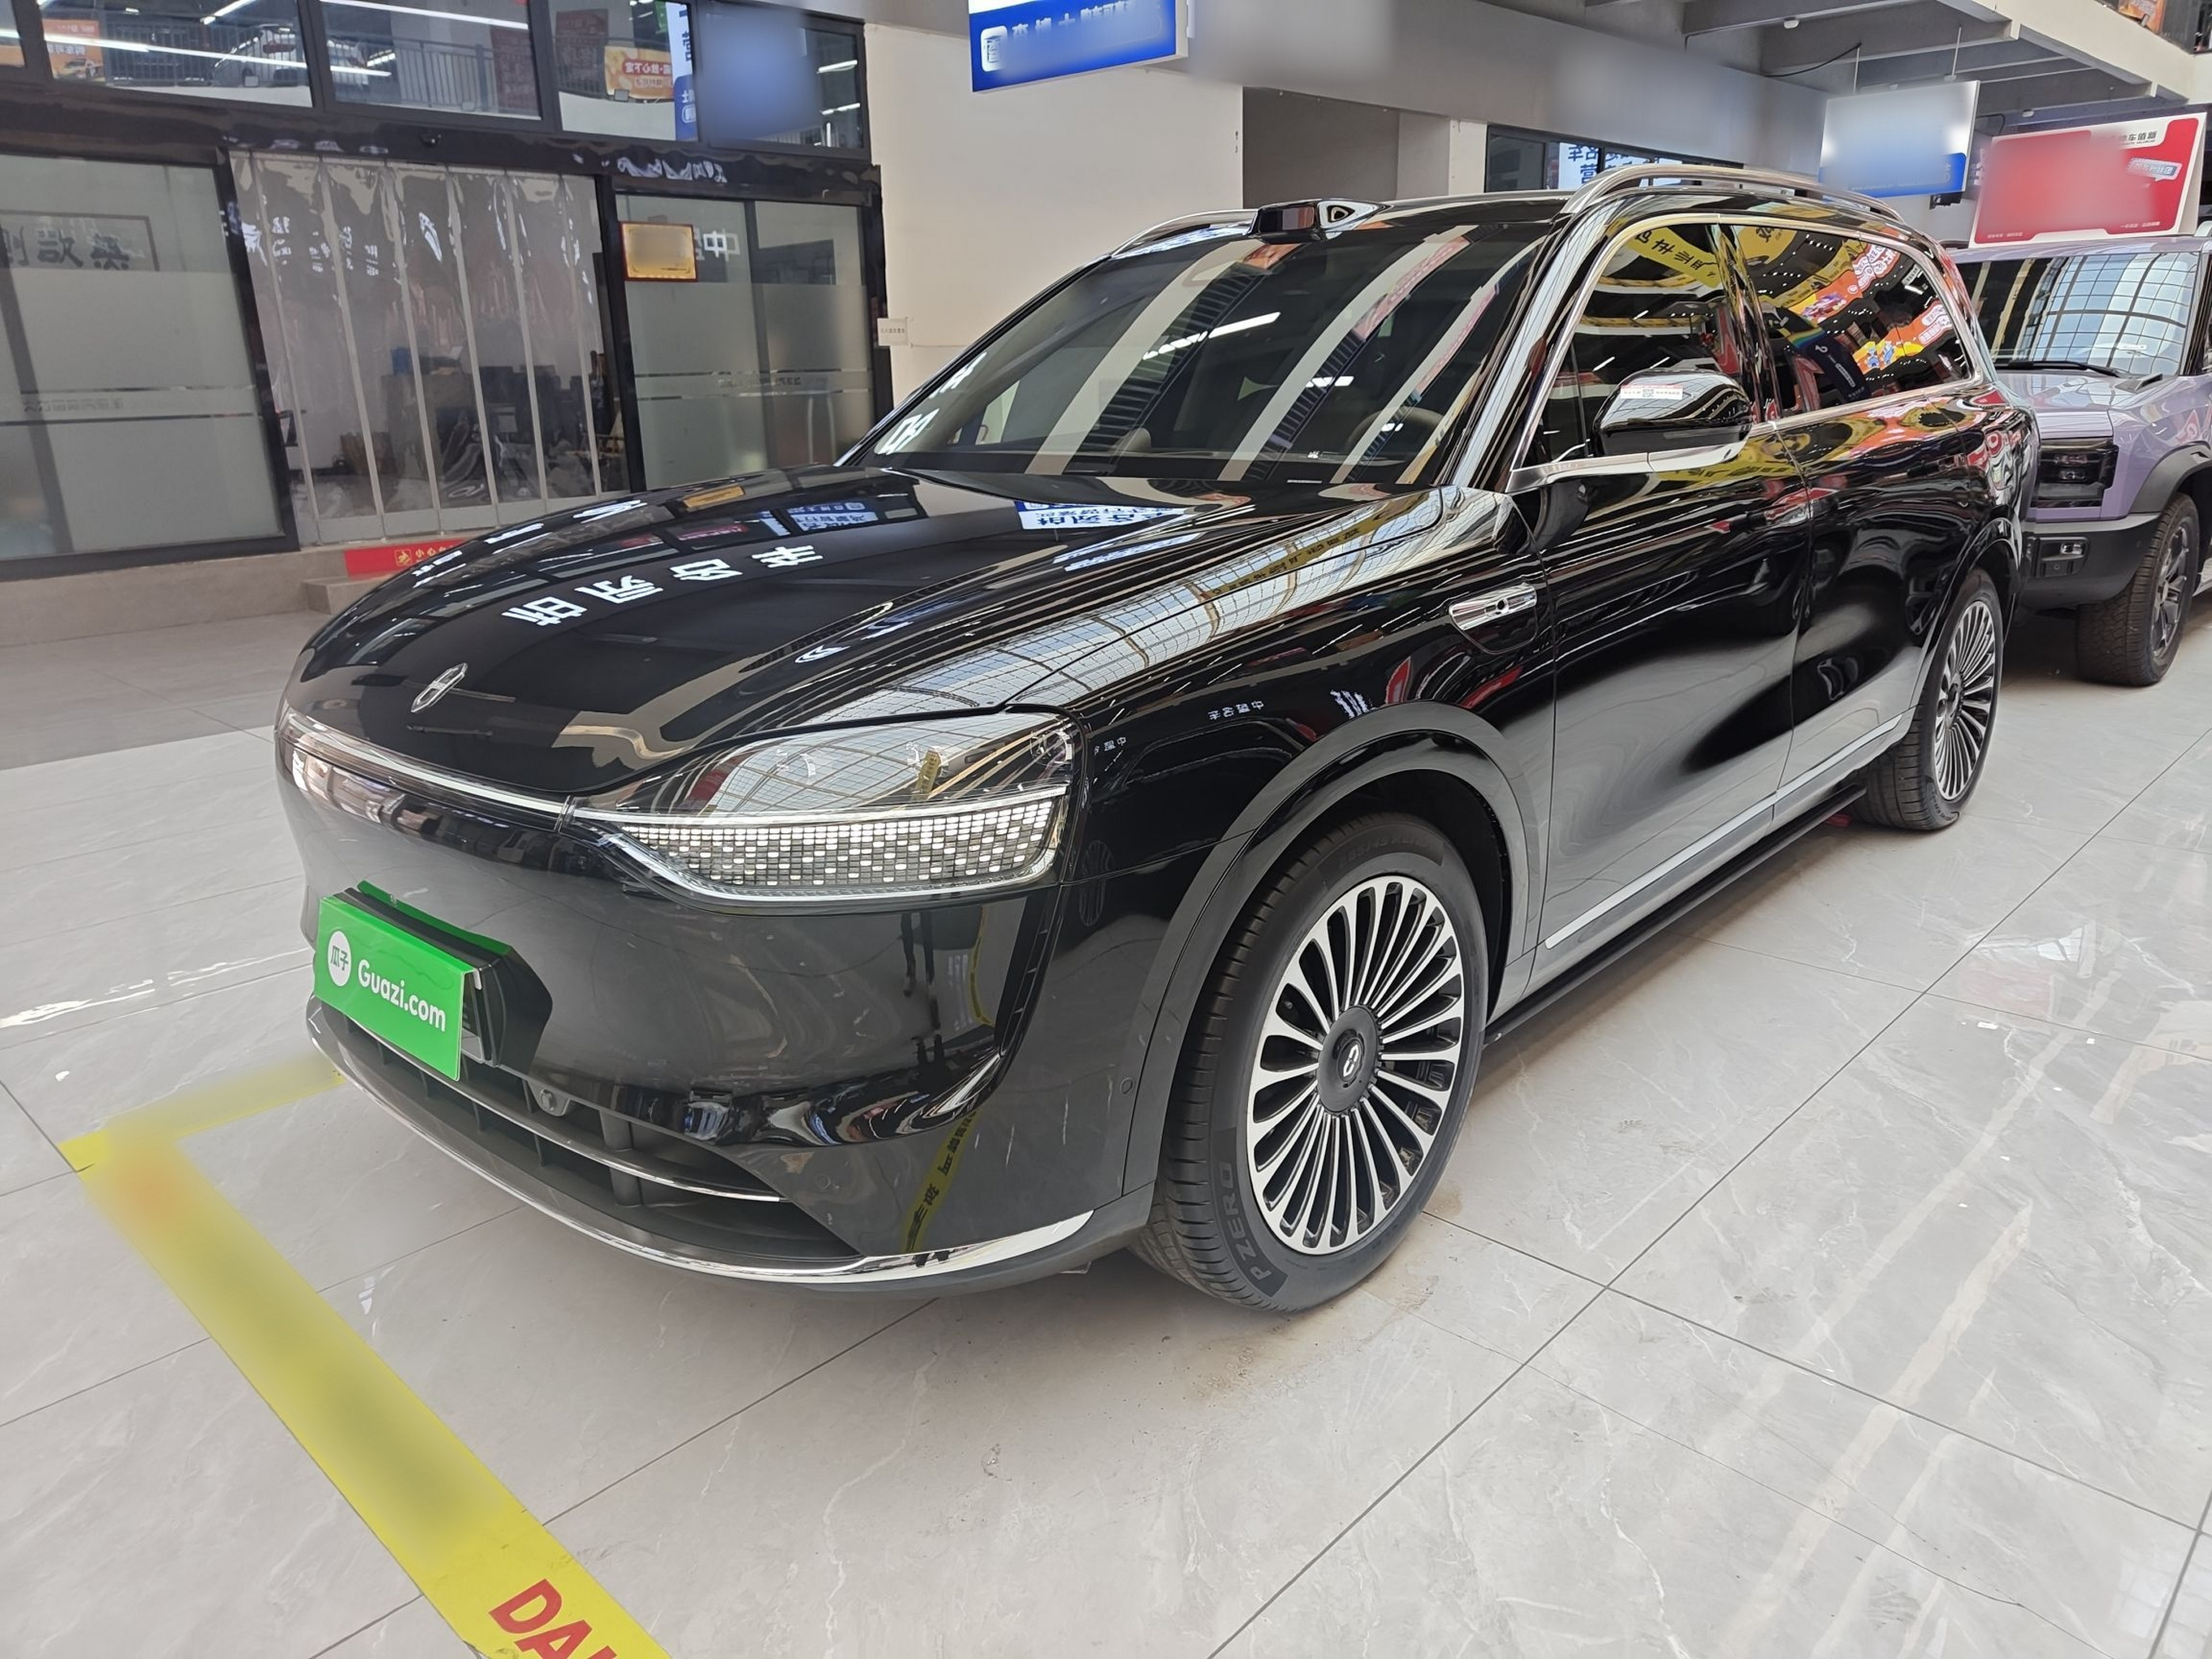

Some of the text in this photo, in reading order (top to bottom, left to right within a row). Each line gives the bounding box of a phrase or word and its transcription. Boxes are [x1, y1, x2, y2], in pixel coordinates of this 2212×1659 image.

[330, 945, 349, 971] 瓜子
[358, 959, 446, 1032] Guazi.com
[1219, 1161, 1272, 1281] P ZERO
[488, 1578, 618, 1659] DA
